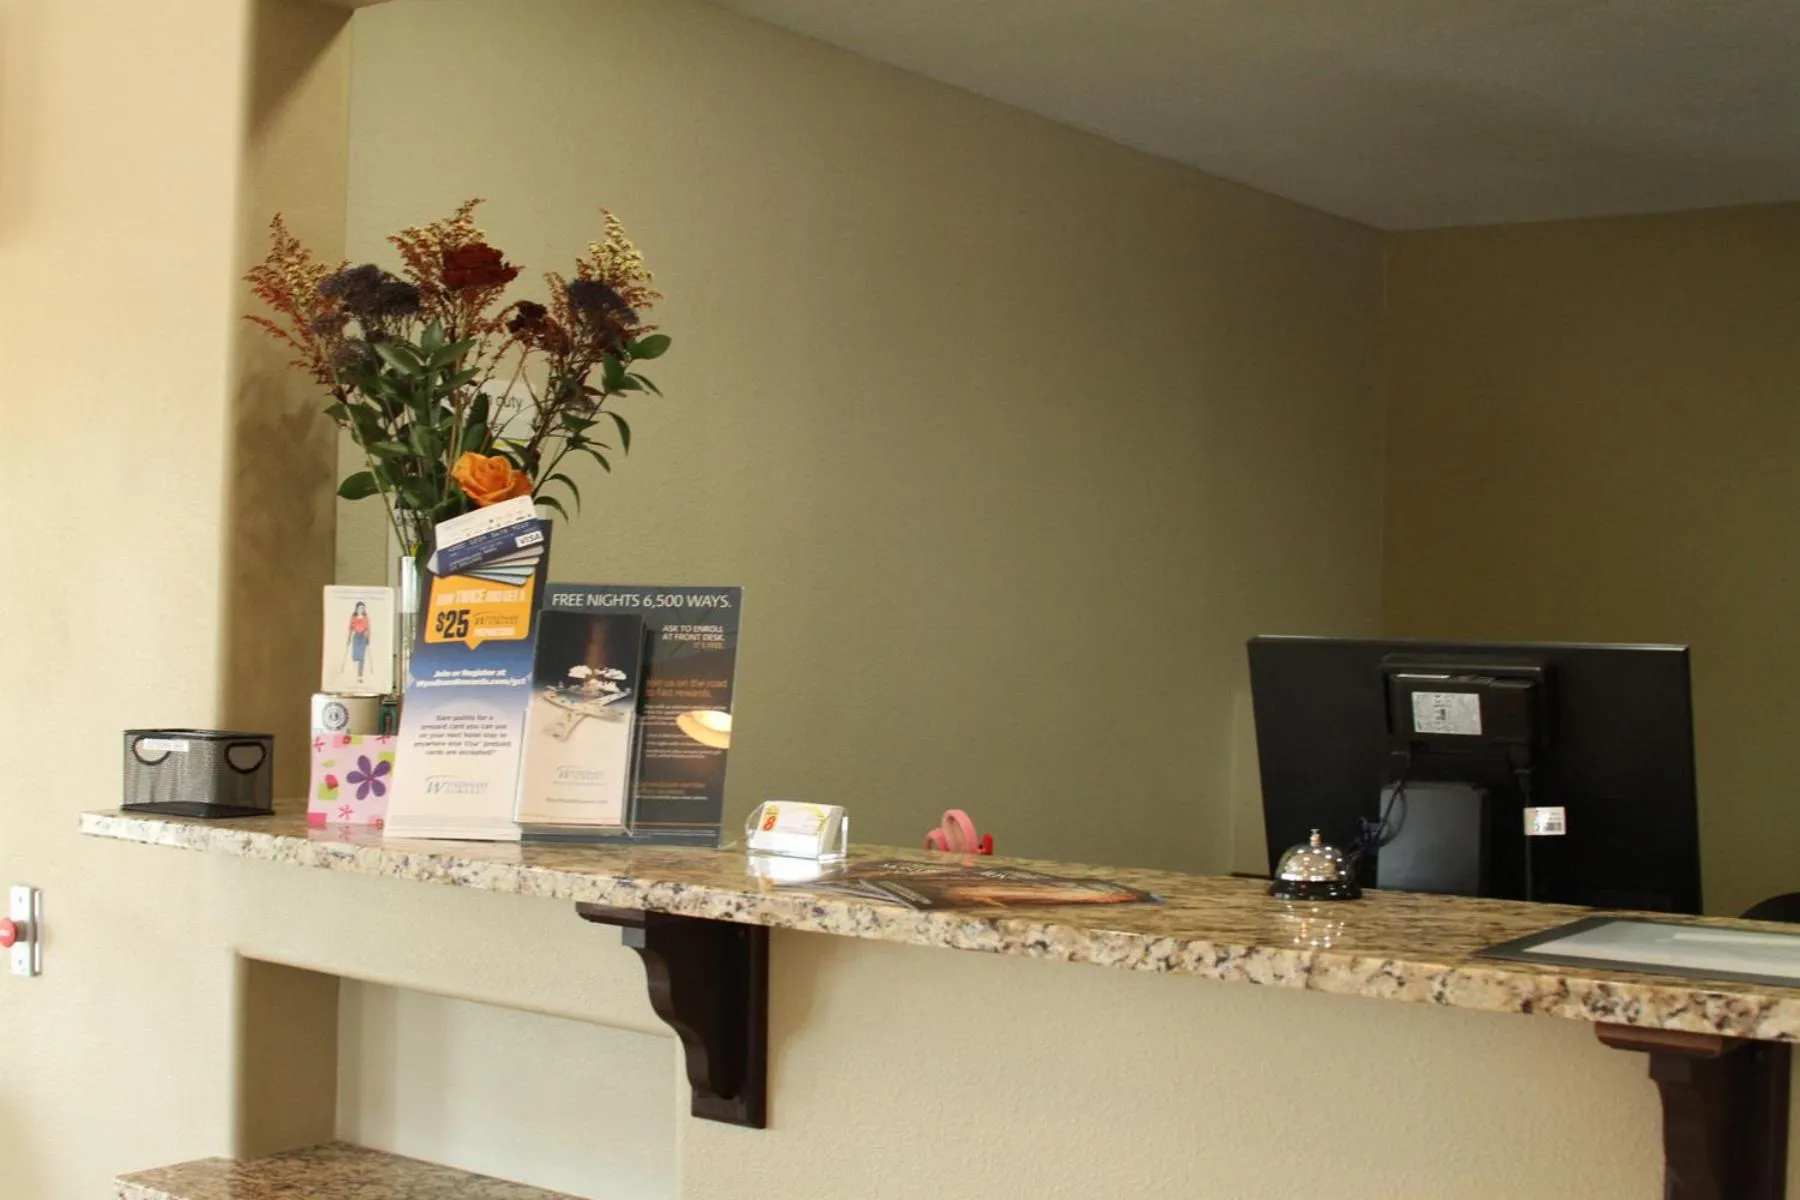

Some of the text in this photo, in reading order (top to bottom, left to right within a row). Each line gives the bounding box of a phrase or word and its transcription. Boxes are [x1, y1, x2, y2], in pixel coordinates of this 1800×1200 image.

[552, 593, 732, 609] FREE NIGHTS 6,500 WAYS.
[435, 609, 469, 638] $25
[693, 625, 725, 633] ENROLL
[662, 633, 673, 641] AT
[674, 633, 701, 641] FRONT
[763, 815, 777, 831] 8
